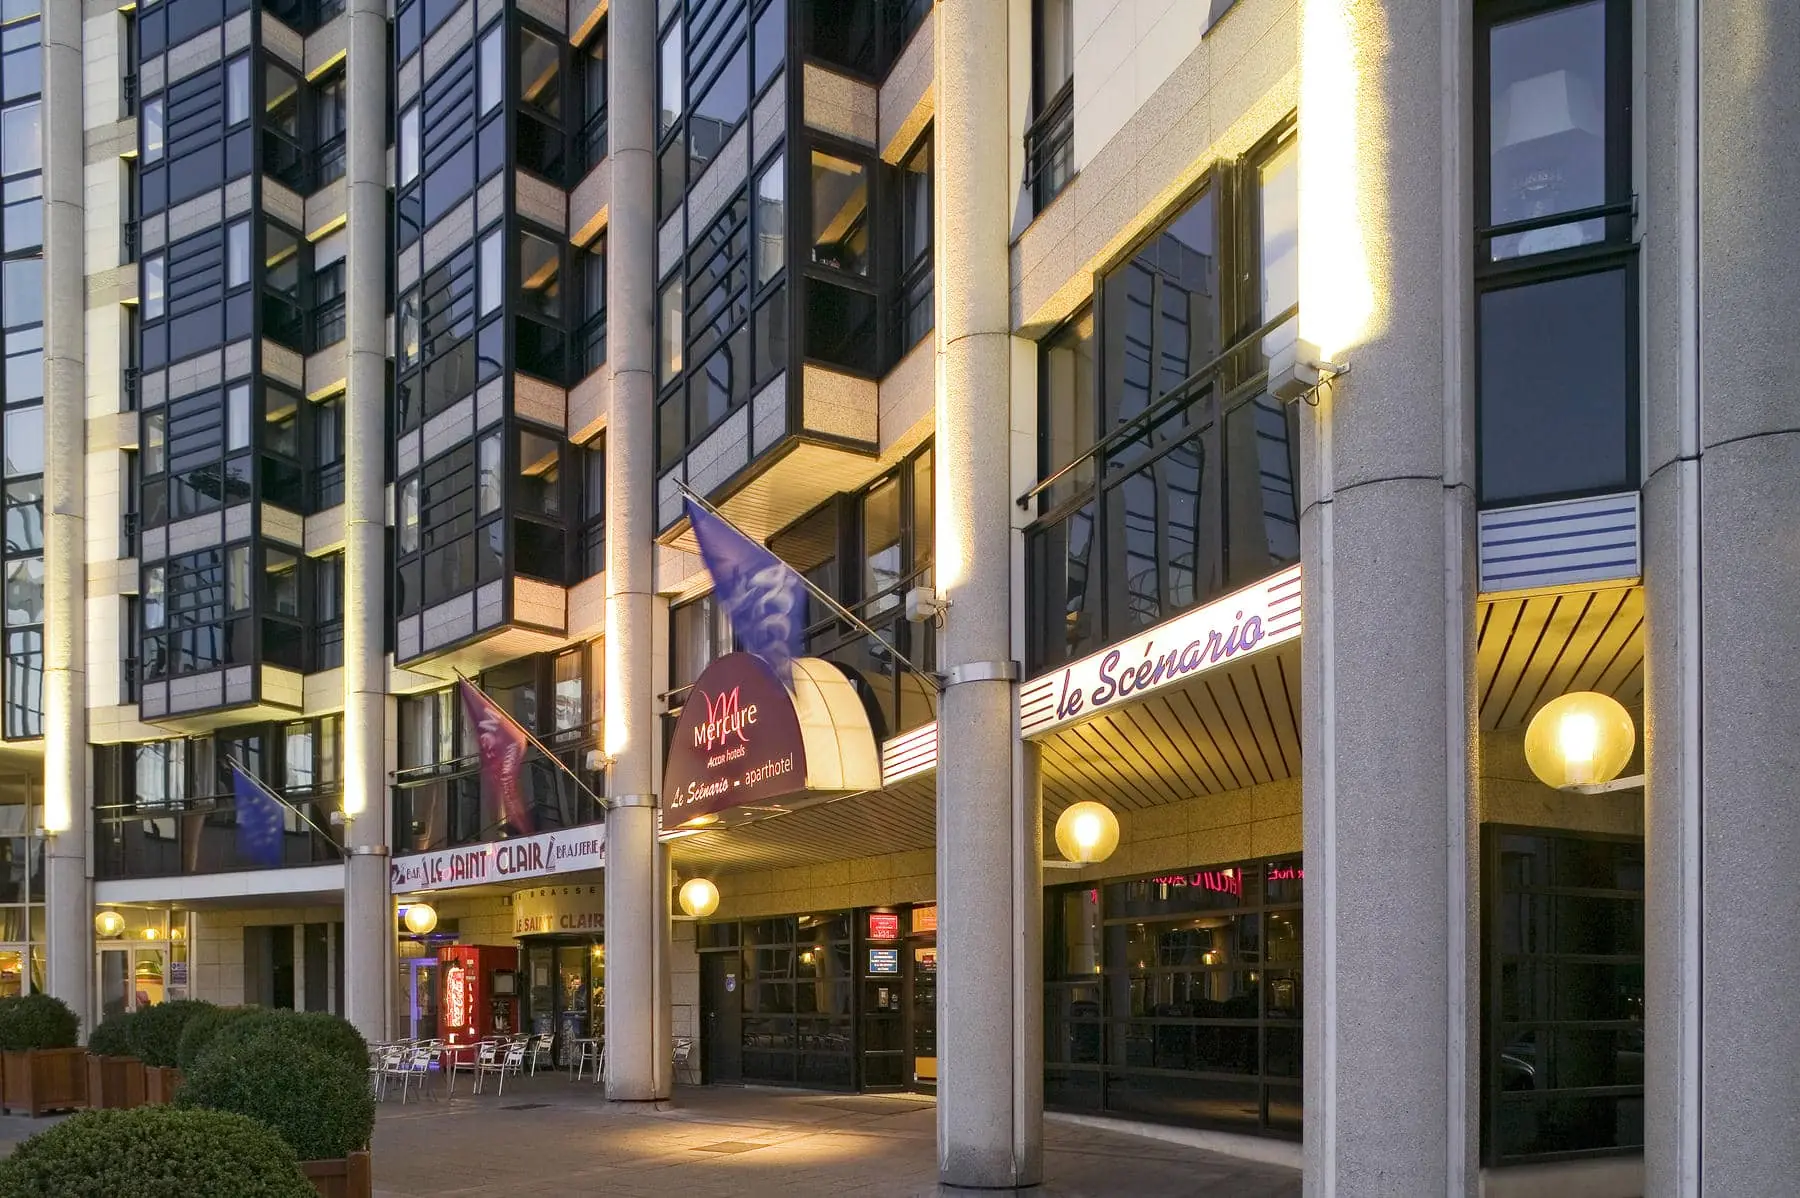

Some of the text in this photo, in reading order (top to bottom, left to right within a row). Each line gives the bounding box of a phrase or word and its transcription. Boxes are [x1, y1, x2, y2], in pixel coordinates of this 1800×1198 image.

[1056, 610, 1265, 721] le Scénario
[694, 704, 758, 748] Mercure
[671, 786, 684, 809] Le
[745, 752, 793, 788] aparthotel
[430, 842, 545, 884] LE SAINT CLAIR
[556, 839, 599, 860] BRASSERIE
[524, 914, 553, 932] SAINT
[560, 912, 605, 929] CLAIR
